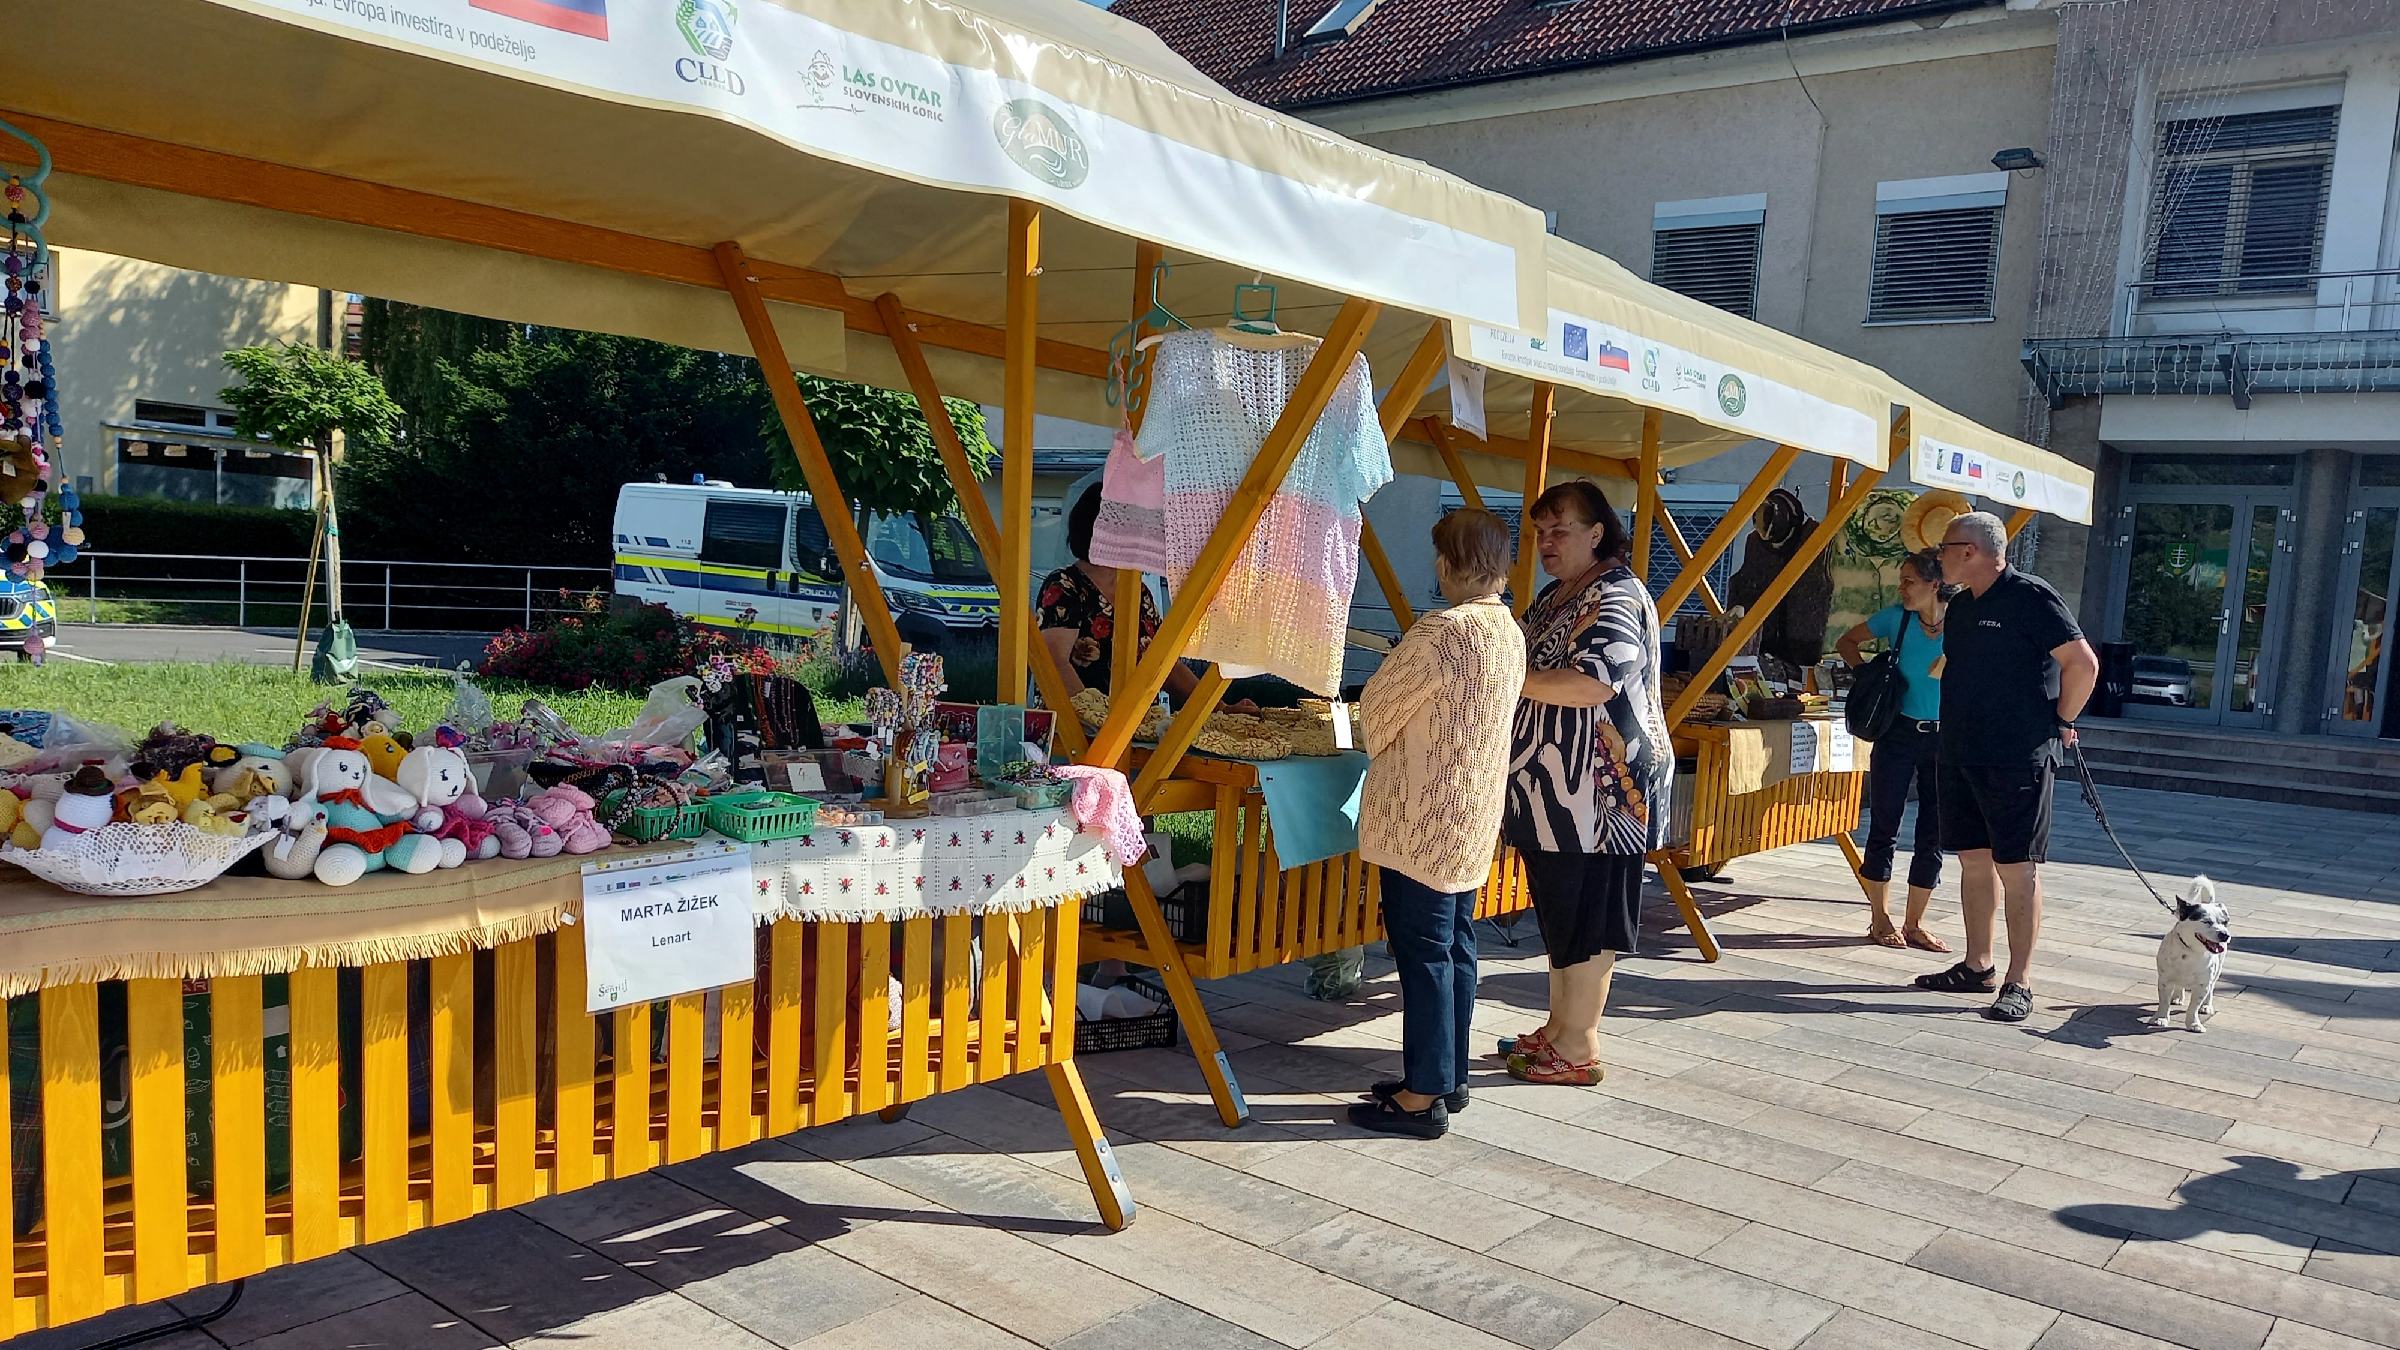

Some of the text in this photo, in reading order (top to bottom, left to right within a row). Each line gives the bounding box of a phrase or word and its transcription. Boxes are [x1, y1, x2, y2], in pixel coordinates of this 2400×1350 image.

[390, 6, 453, 39] investira
[456, 27, 465, 42] v
[469, 30, 536, 61] podeželje
[675, 57, 745, 97] CLLD
[842, 65, 942, 108] LAS OVTAR
[843, 86, 944, 122] SLOVENSKIH GORIC
[799, 588, 839, 600] POLICIJA
[620, 894, 719, 923] MARTA ŽIŽEK
[651, 930, 692, 948] Lenart
